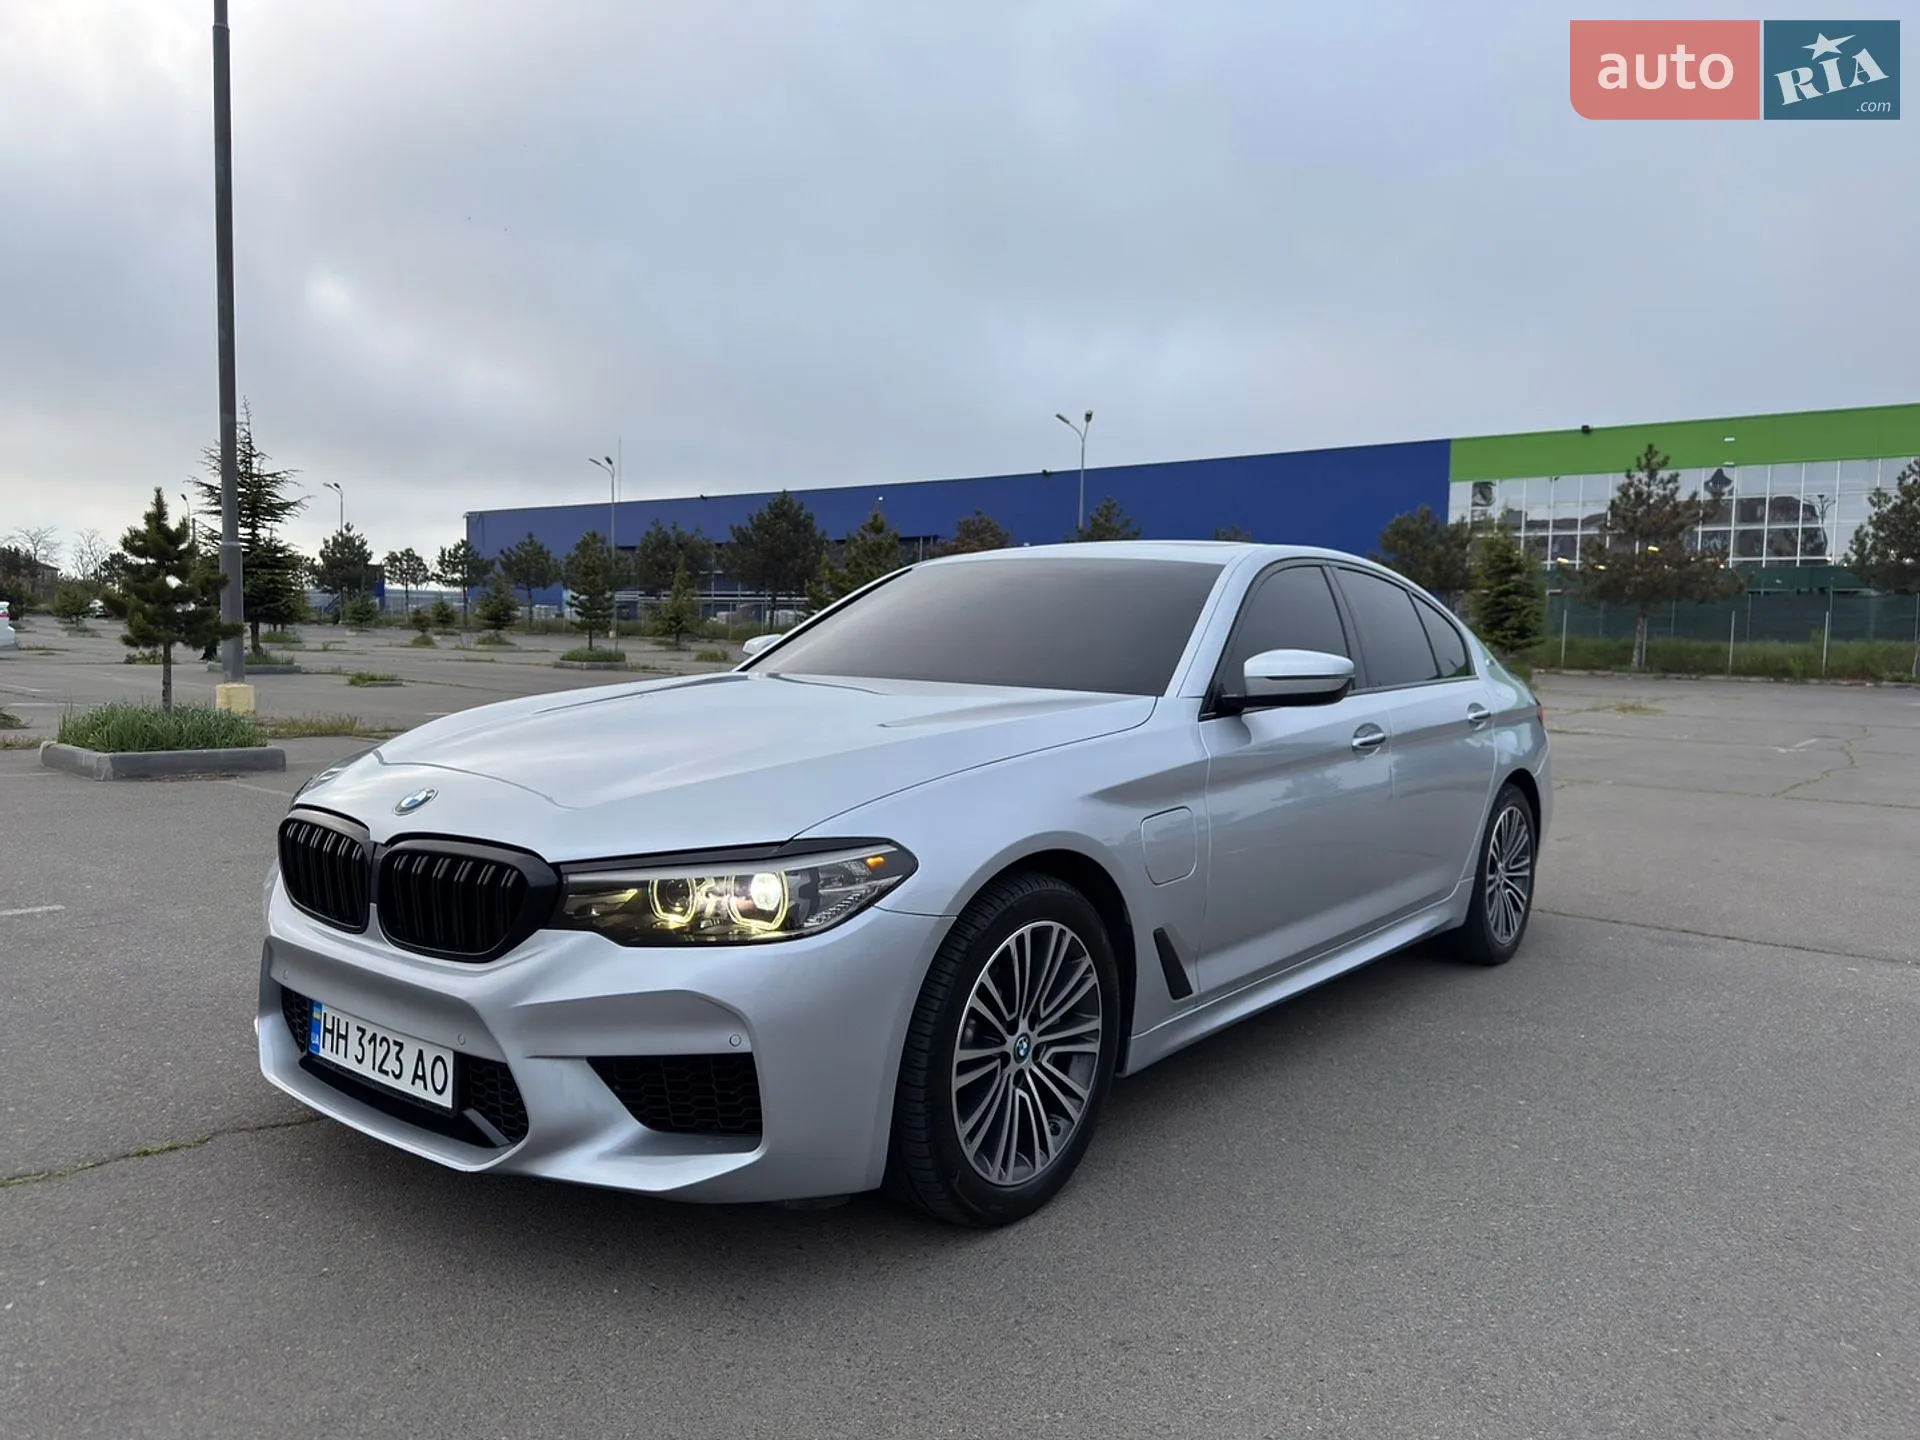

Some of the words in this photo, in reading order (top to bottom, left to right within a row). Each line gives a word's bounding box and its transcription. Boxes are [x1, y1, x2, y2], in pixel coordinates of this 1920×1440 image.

[322, 1012, 349, 1059] HH
[354, 1025, 404, 1080] 3123
[411, 1048, 448, 1096] AO
